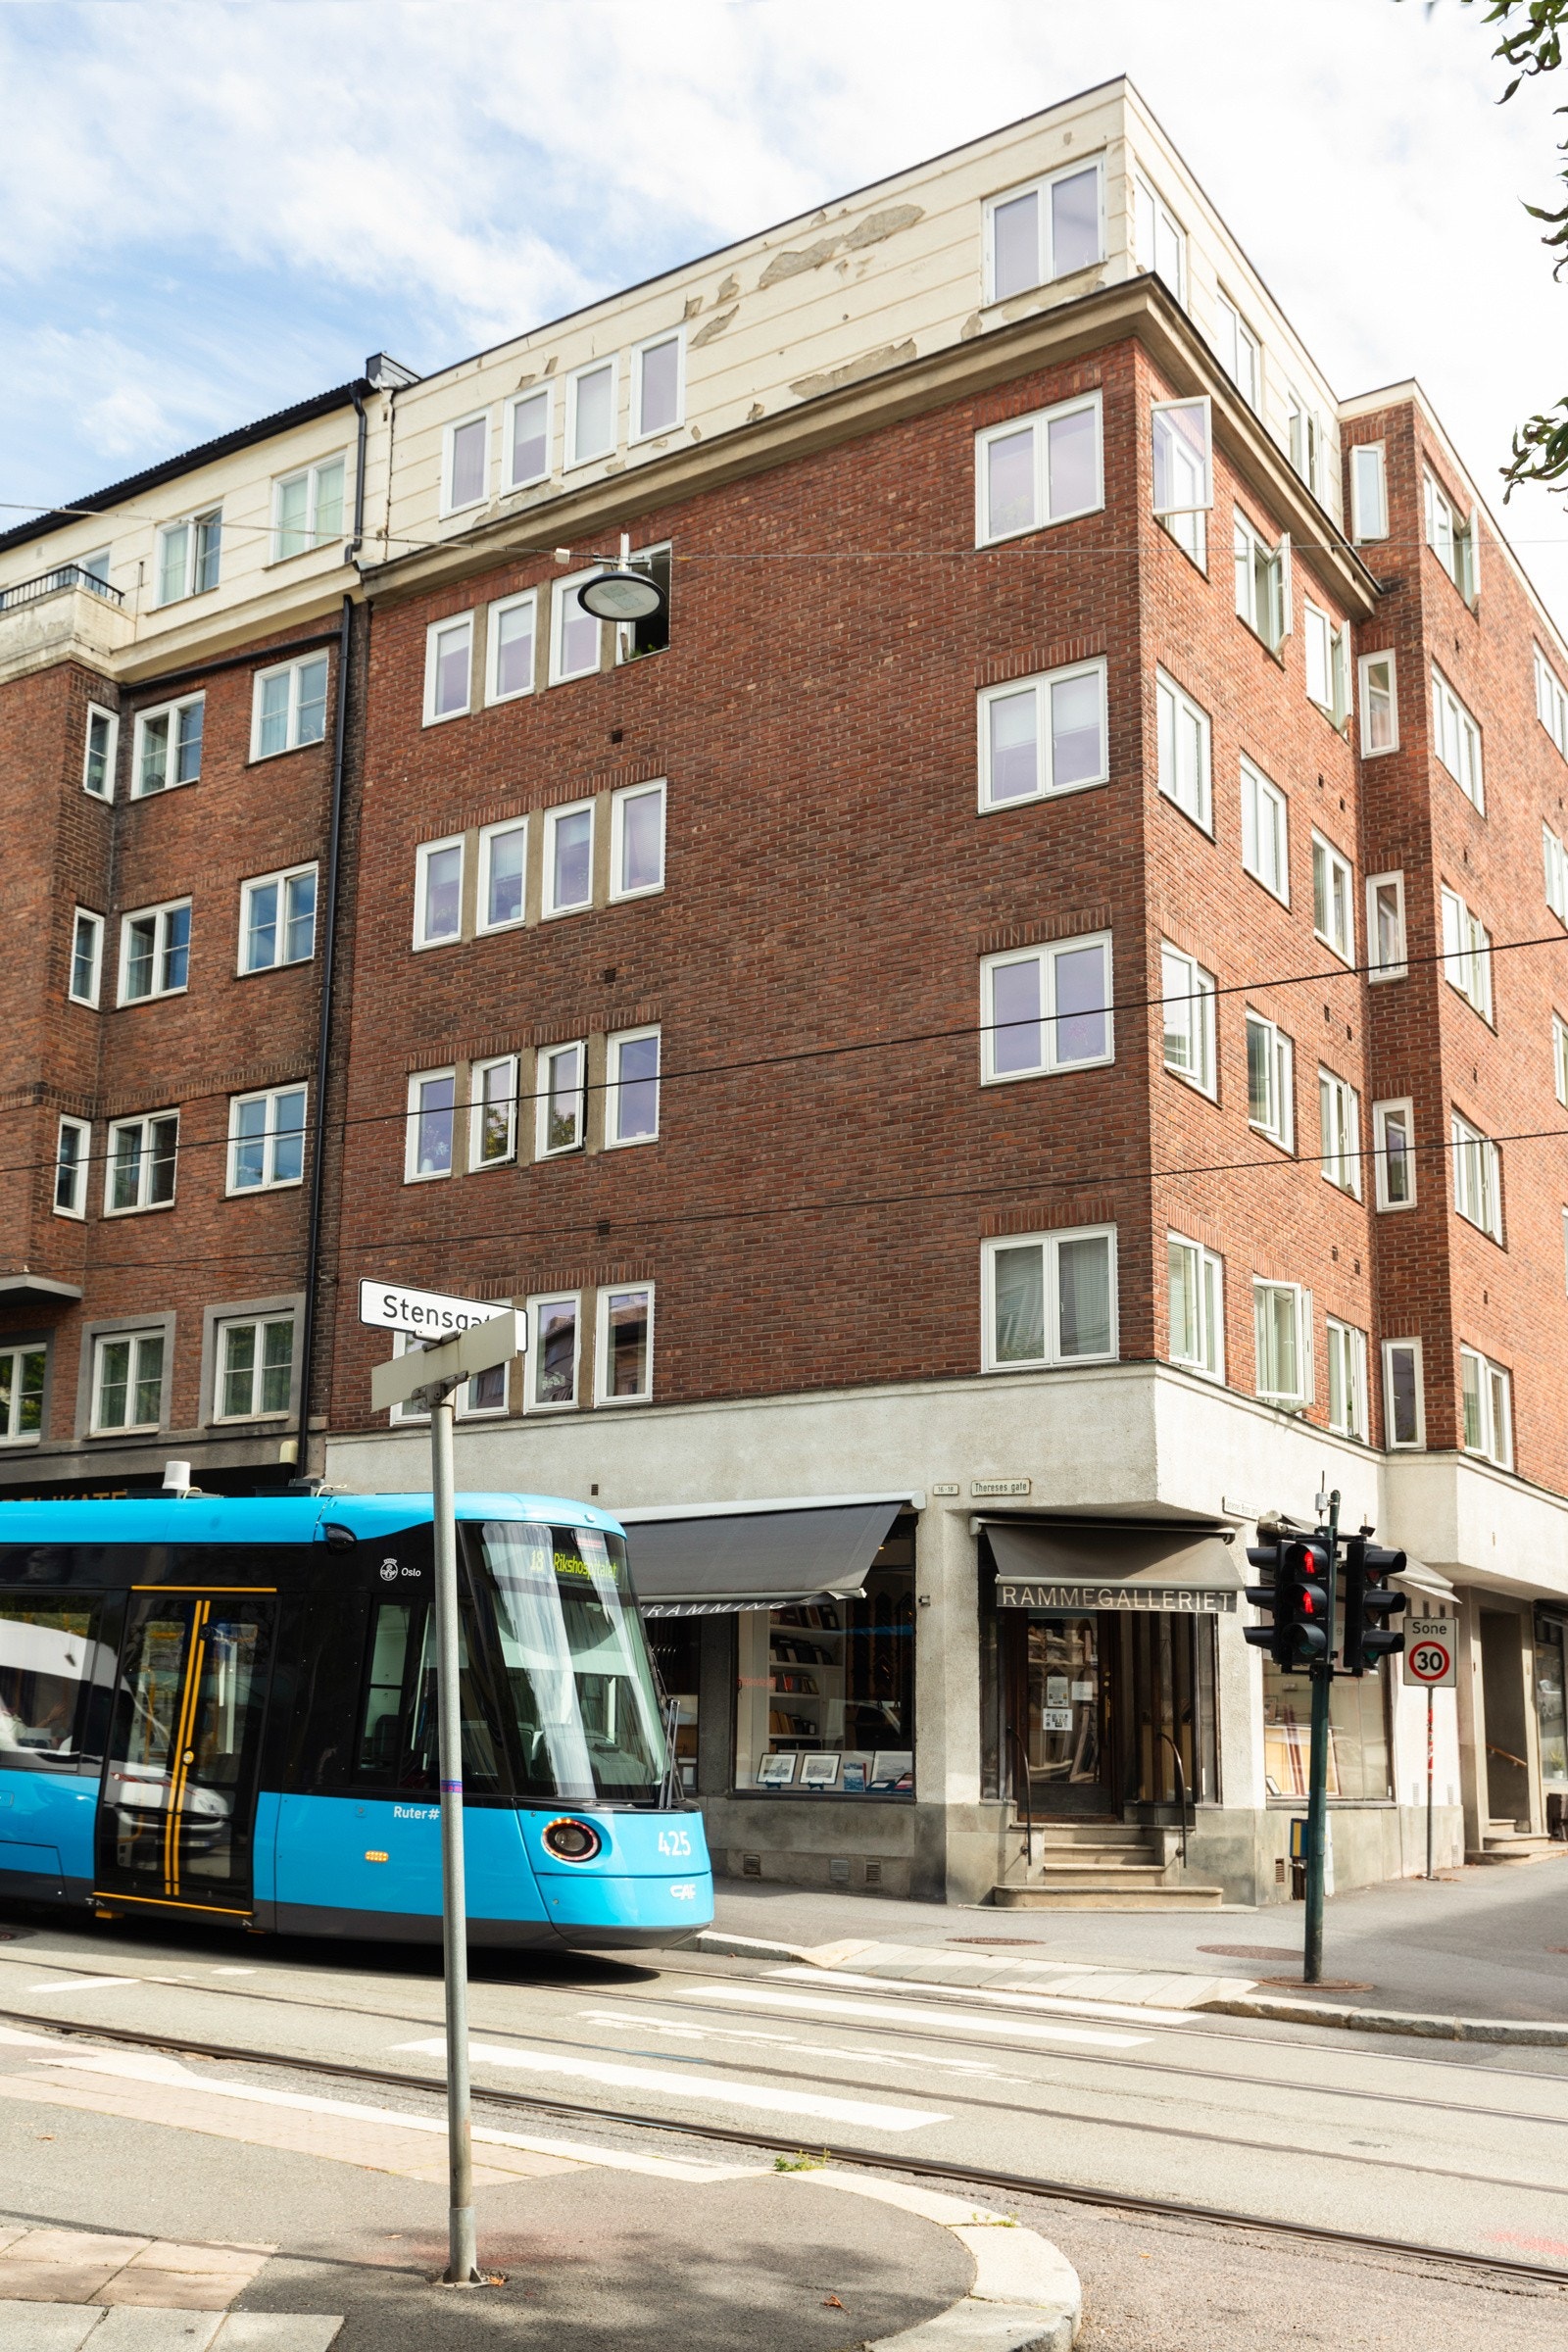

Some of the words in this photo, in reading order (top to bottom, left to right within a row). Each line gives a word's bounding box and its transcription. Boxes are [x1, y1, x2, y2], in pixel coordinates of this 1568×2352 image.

[975, 1483, 1007, 1493] Thereses
[1010, 1482, 1027, 1494] gate
[401, 1567, 421, 1577] Oslo
[530, 1549, 545, 1573] 18
[554, 1552, 617, 1580] Rikshospitalet
[1002, 1585, 1233, 1612] RAMMEGALLERIET
[1412, 1621, 1447, 1635] Sone
[1417, 1650, 1443, 1671] 30
[658, 1830, 692, 1856] 425
[669, 1884, 697, 1900] CAF
